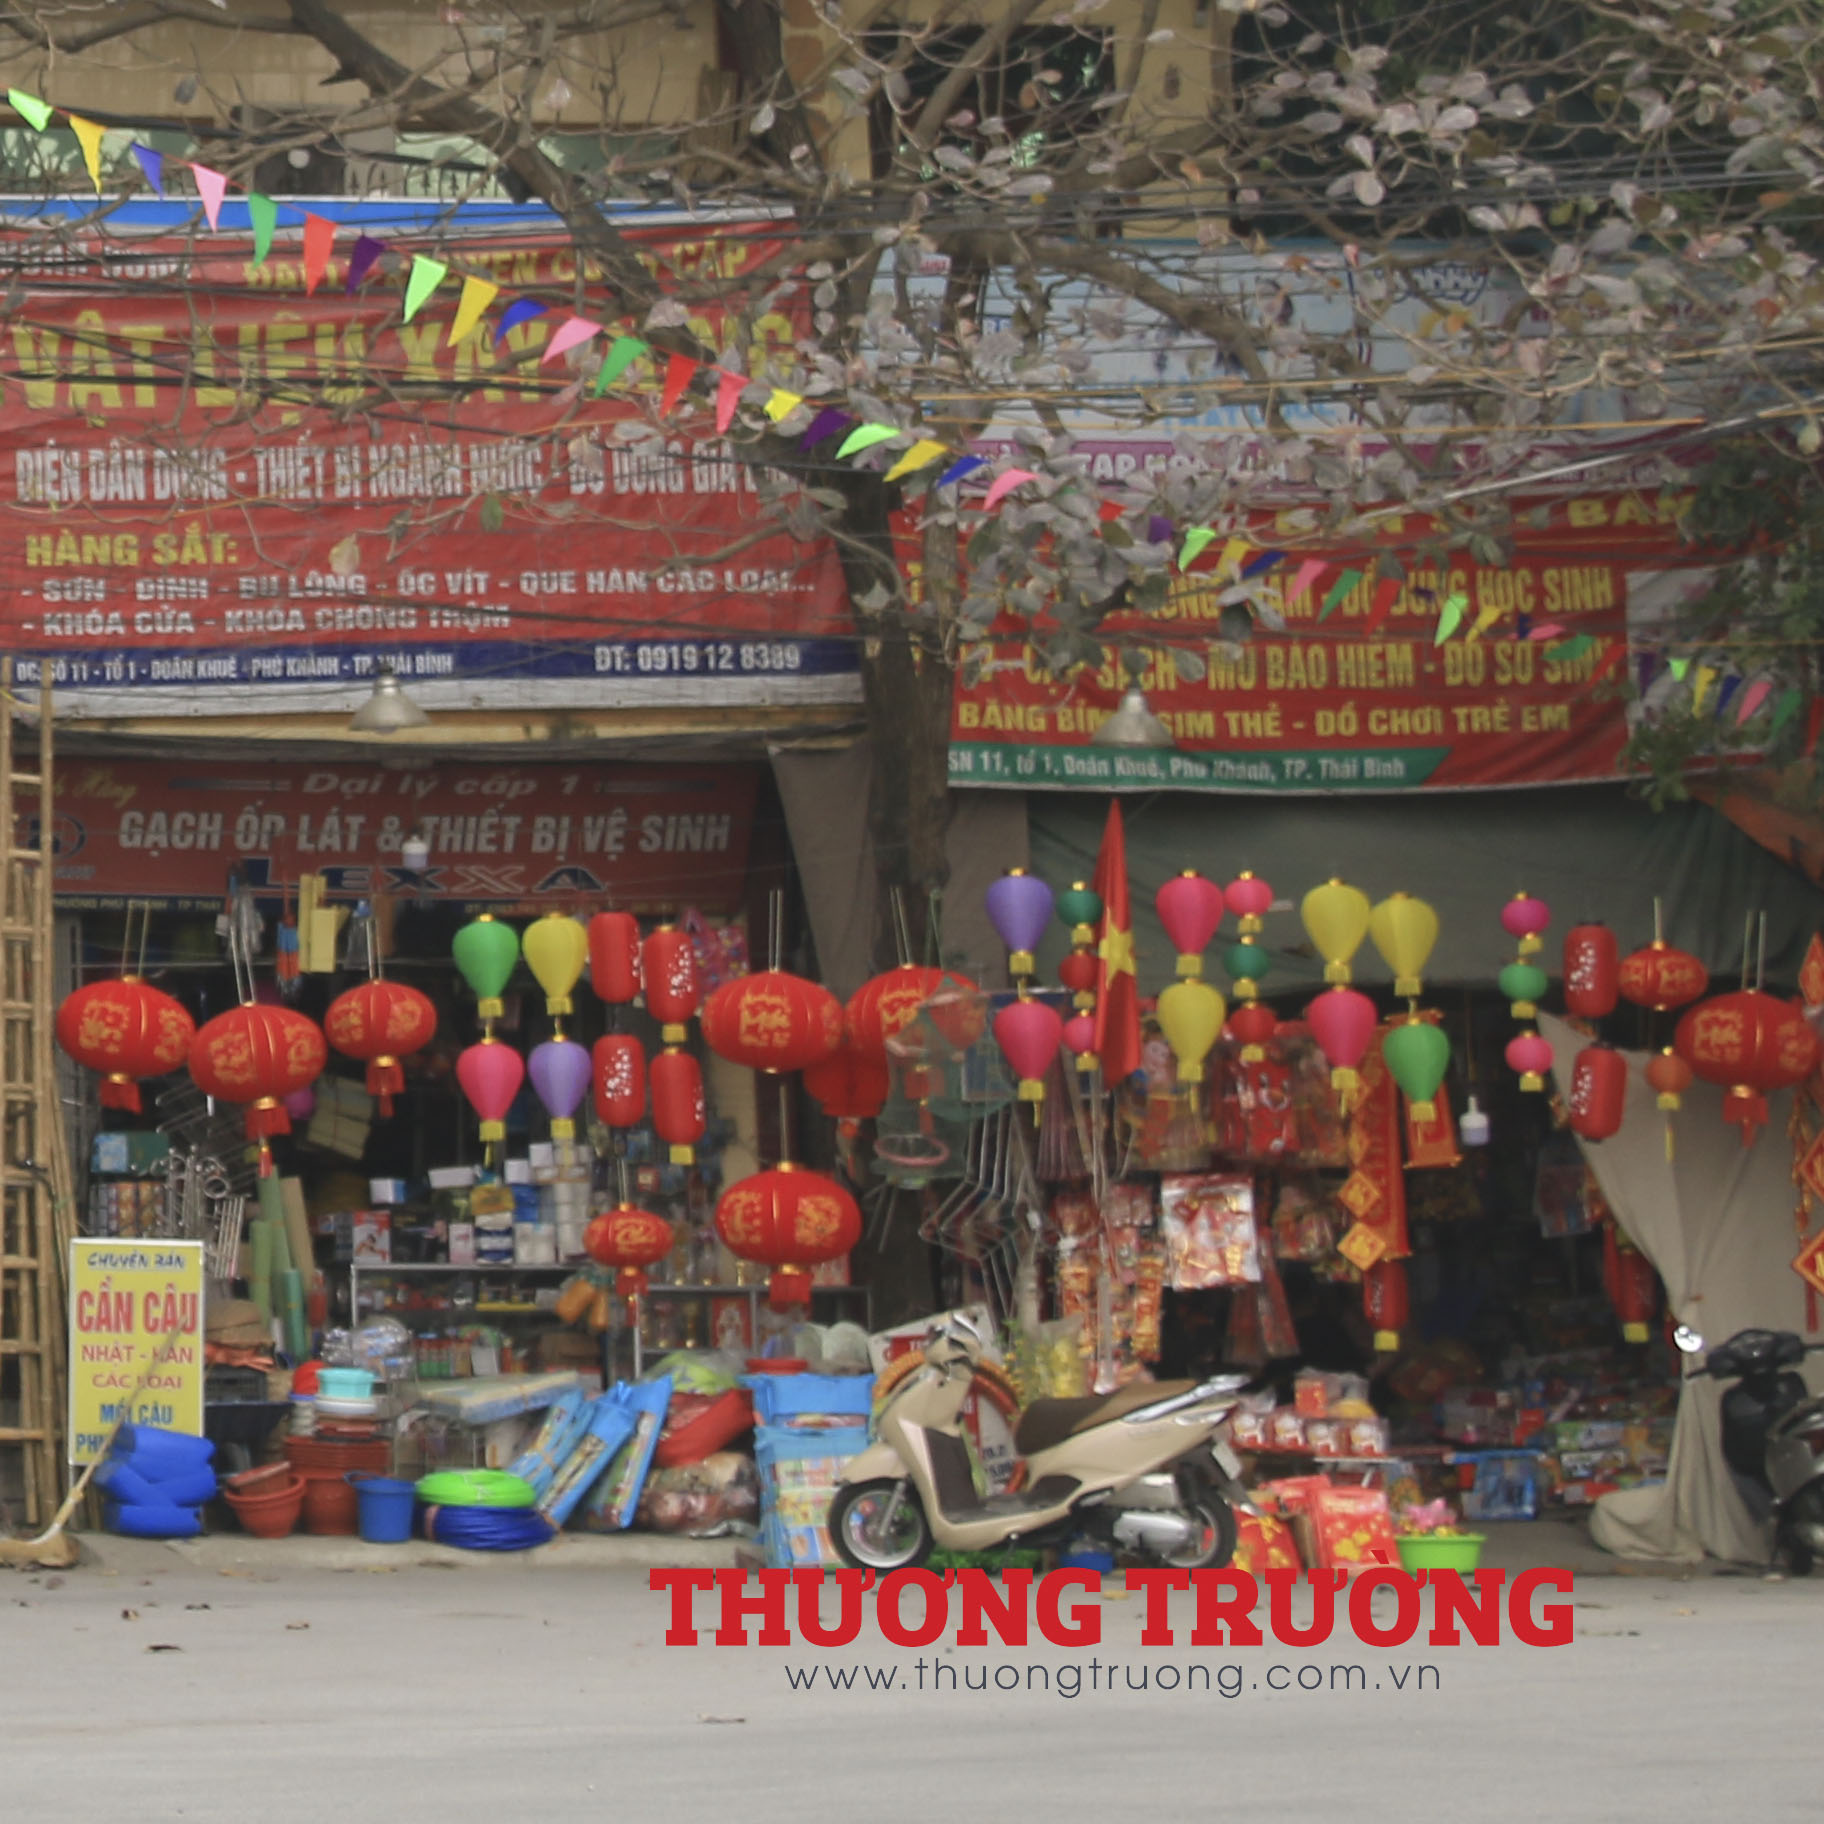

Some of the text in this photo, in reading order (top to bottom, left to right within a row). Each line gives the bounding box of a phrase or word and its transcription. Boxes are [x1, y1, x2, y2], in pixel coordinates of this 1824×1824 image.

[88, 436, 147, 502] DÂN
[254, 429, 326, 500] THIẾT
[334, 444, 363, 510] BỊ
[26, 528, 139, 567] HÀNG
[445, 565, 490, 596] VÍT
[519, 569, 577, 595] QUE
[586, 564, 648, 593] HÀN
[1543, 565, 1615, 614] SINH
[70, 661, 90, 681] 11
[594, 645, 632, 672] ĐT:
[637, 644, 697, 670] 0919
[706, 643, 734, 669] 12
[958, 700, 1047, 734] BĂNG
[1224, 699, 1283, 739] THẺ
[1367, 703, 1444, 736] CHƠI
[1453, 697, 1513, 734] TRẺ
[1520, 703, 1571, 733] EM
[301, 772, 386, 801] Đại
[398, 773, 440, 802] lý
[453, 770, 539, 802] cấp
[117, 808, 225, 859] GẠCH
[296, 804, 368, 854] LÁT
[418, 802, 524, 855] THIẾT
[530, 813, 572, 863] BỊ
[583, 806, 630, 863] VỆ
[638, 812, 732, 855] SINH
[87, 1250, 148, 1268] CHUYÊN
[76, 1275, 198, 1335] CẦN CÂU
[81, 1341, 135, 1368] NHẬT
[91, 1372, 132, 1390] CÁC
